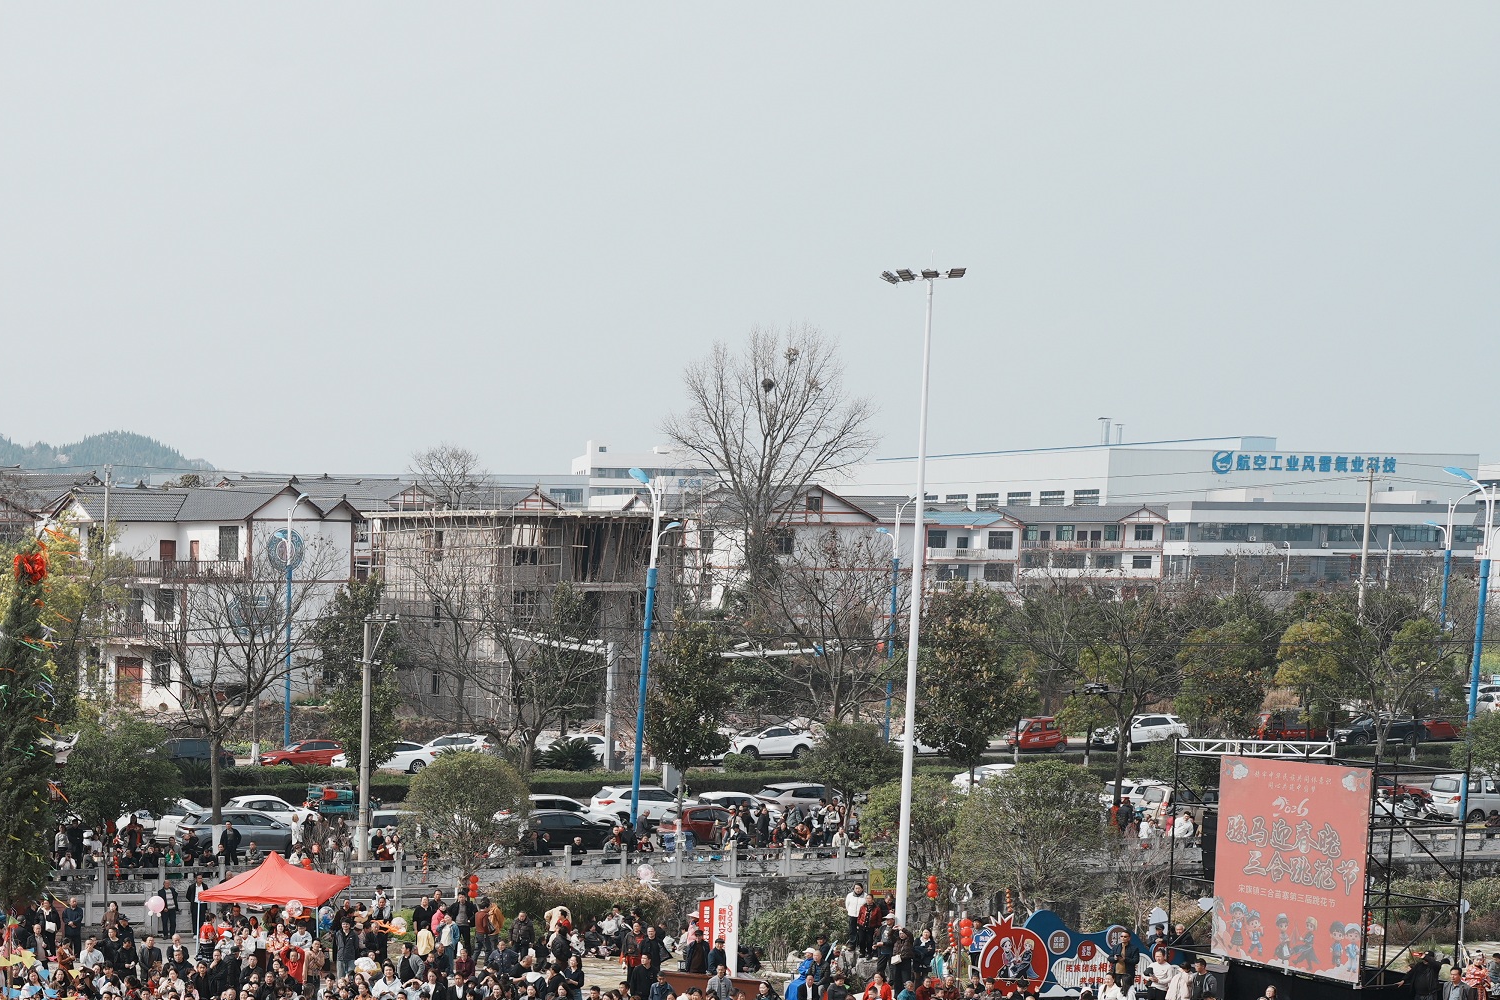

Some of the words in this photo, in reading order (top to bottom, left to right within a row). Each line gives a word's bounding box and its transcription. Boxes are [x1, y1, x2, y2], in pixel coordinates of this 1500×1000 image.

[1272, 796, 1310, 818] 2026
[1225, 814, 1342, 858] 骏马迎春晓
[1242, 850, 1361, 896] 三合跳花节
